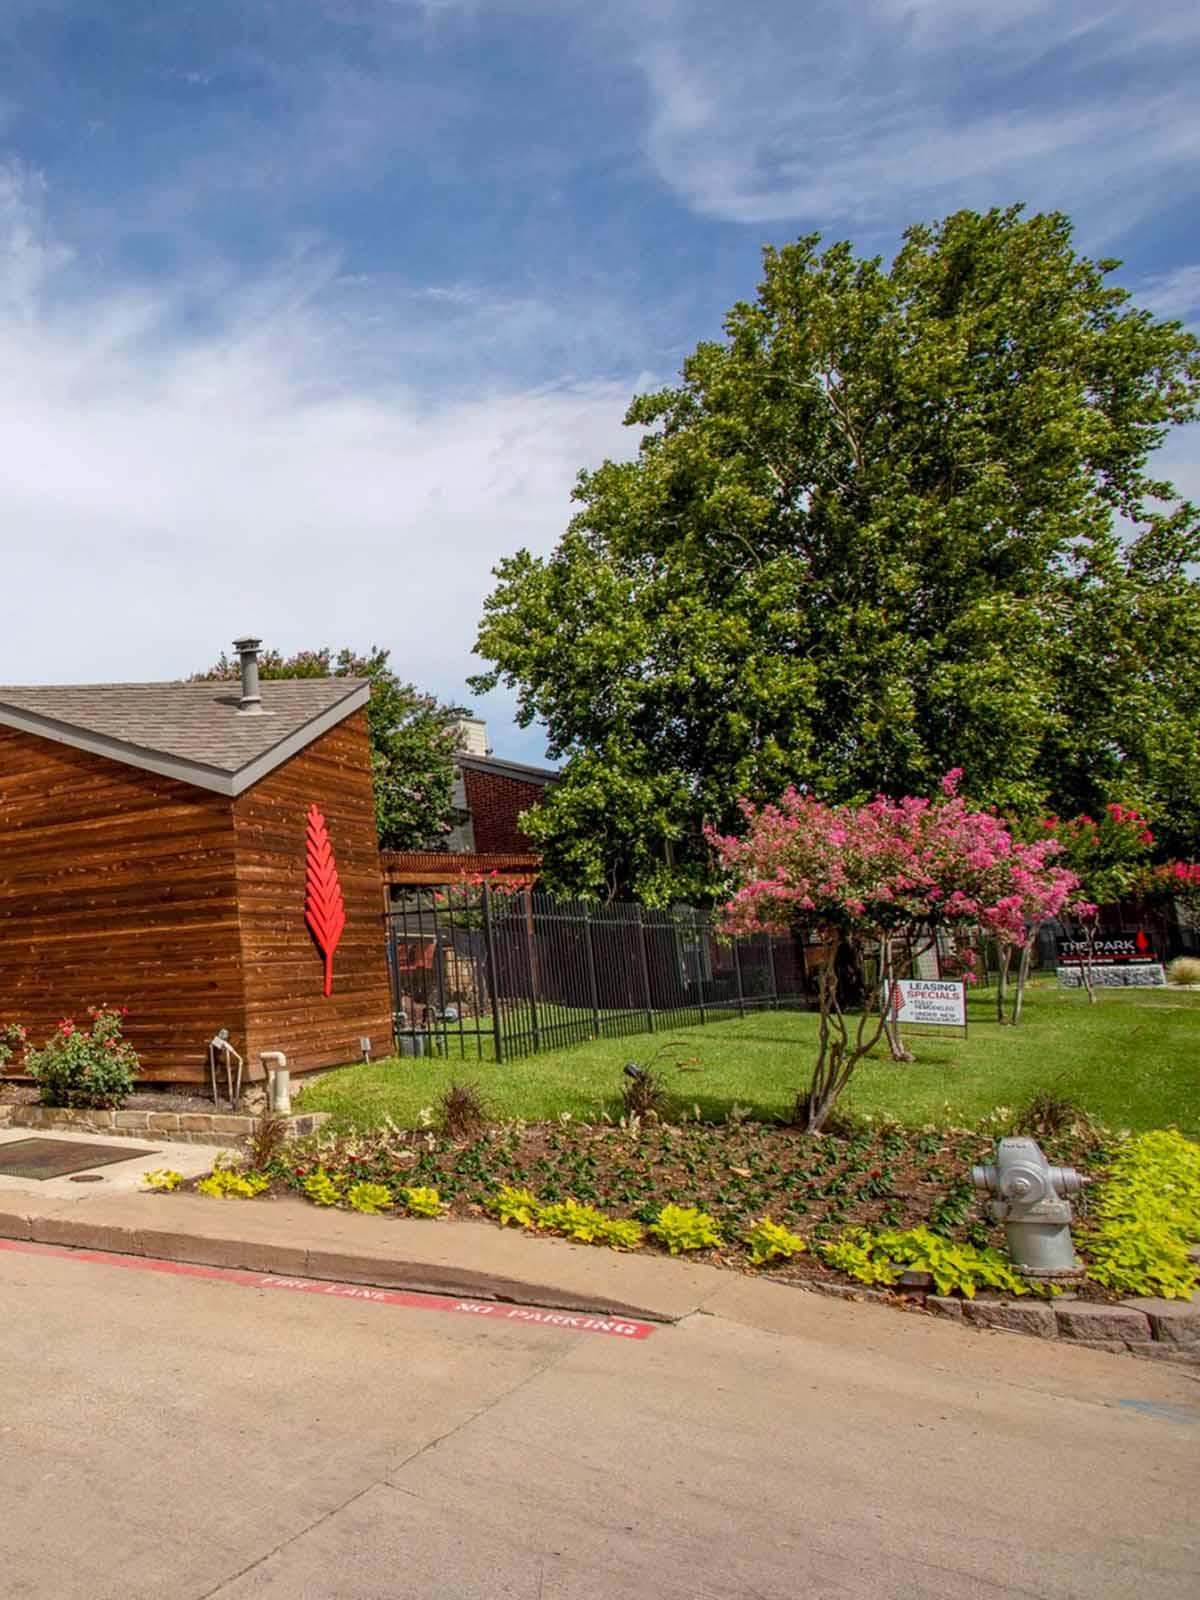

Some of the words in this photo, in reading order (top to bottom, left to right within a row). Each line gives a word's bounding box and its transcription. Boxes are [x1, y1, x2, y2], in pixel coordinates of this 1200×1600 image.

[1061, 942, 1088, 951] THE
[1094, 940, 1135, 950] PARK
[910, 983, 957, 992] LEASING
[907, 991, 960, 1000] SPECIALS
[261, 1278, 310, 1288] FIRE
[325, 1285, 392, 1300] LANE
[456, 1302, 495, 1314] NO
[507, 1310, 638, 1335] PARKING
